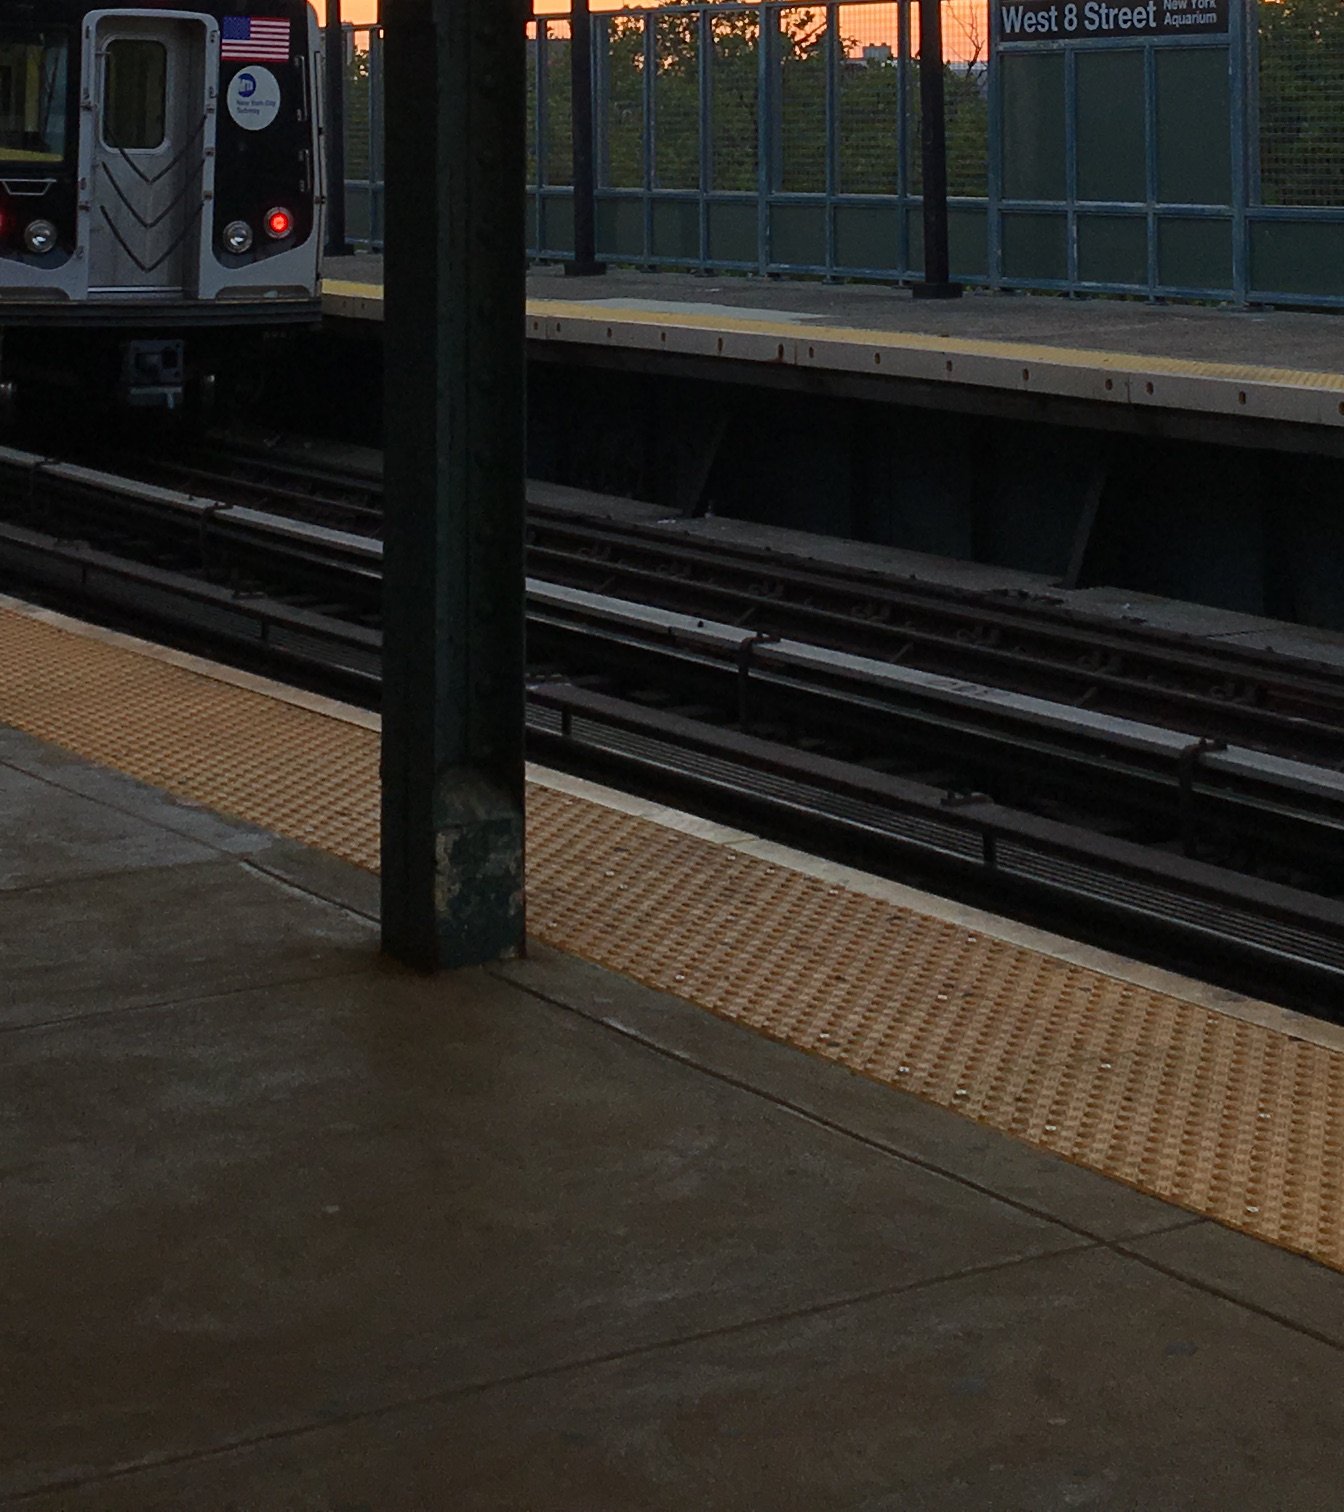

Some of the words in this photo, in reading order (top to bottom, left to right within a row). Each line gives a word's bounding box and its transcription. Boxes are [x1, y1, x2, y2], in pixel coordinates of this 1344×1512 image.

[1001, 5, 1058, 34] West
[1063, 2, 1078, 32] 8
[1083, 0, 1157, 31] Street
[1163, 11, 1217, 28] Aquarium
